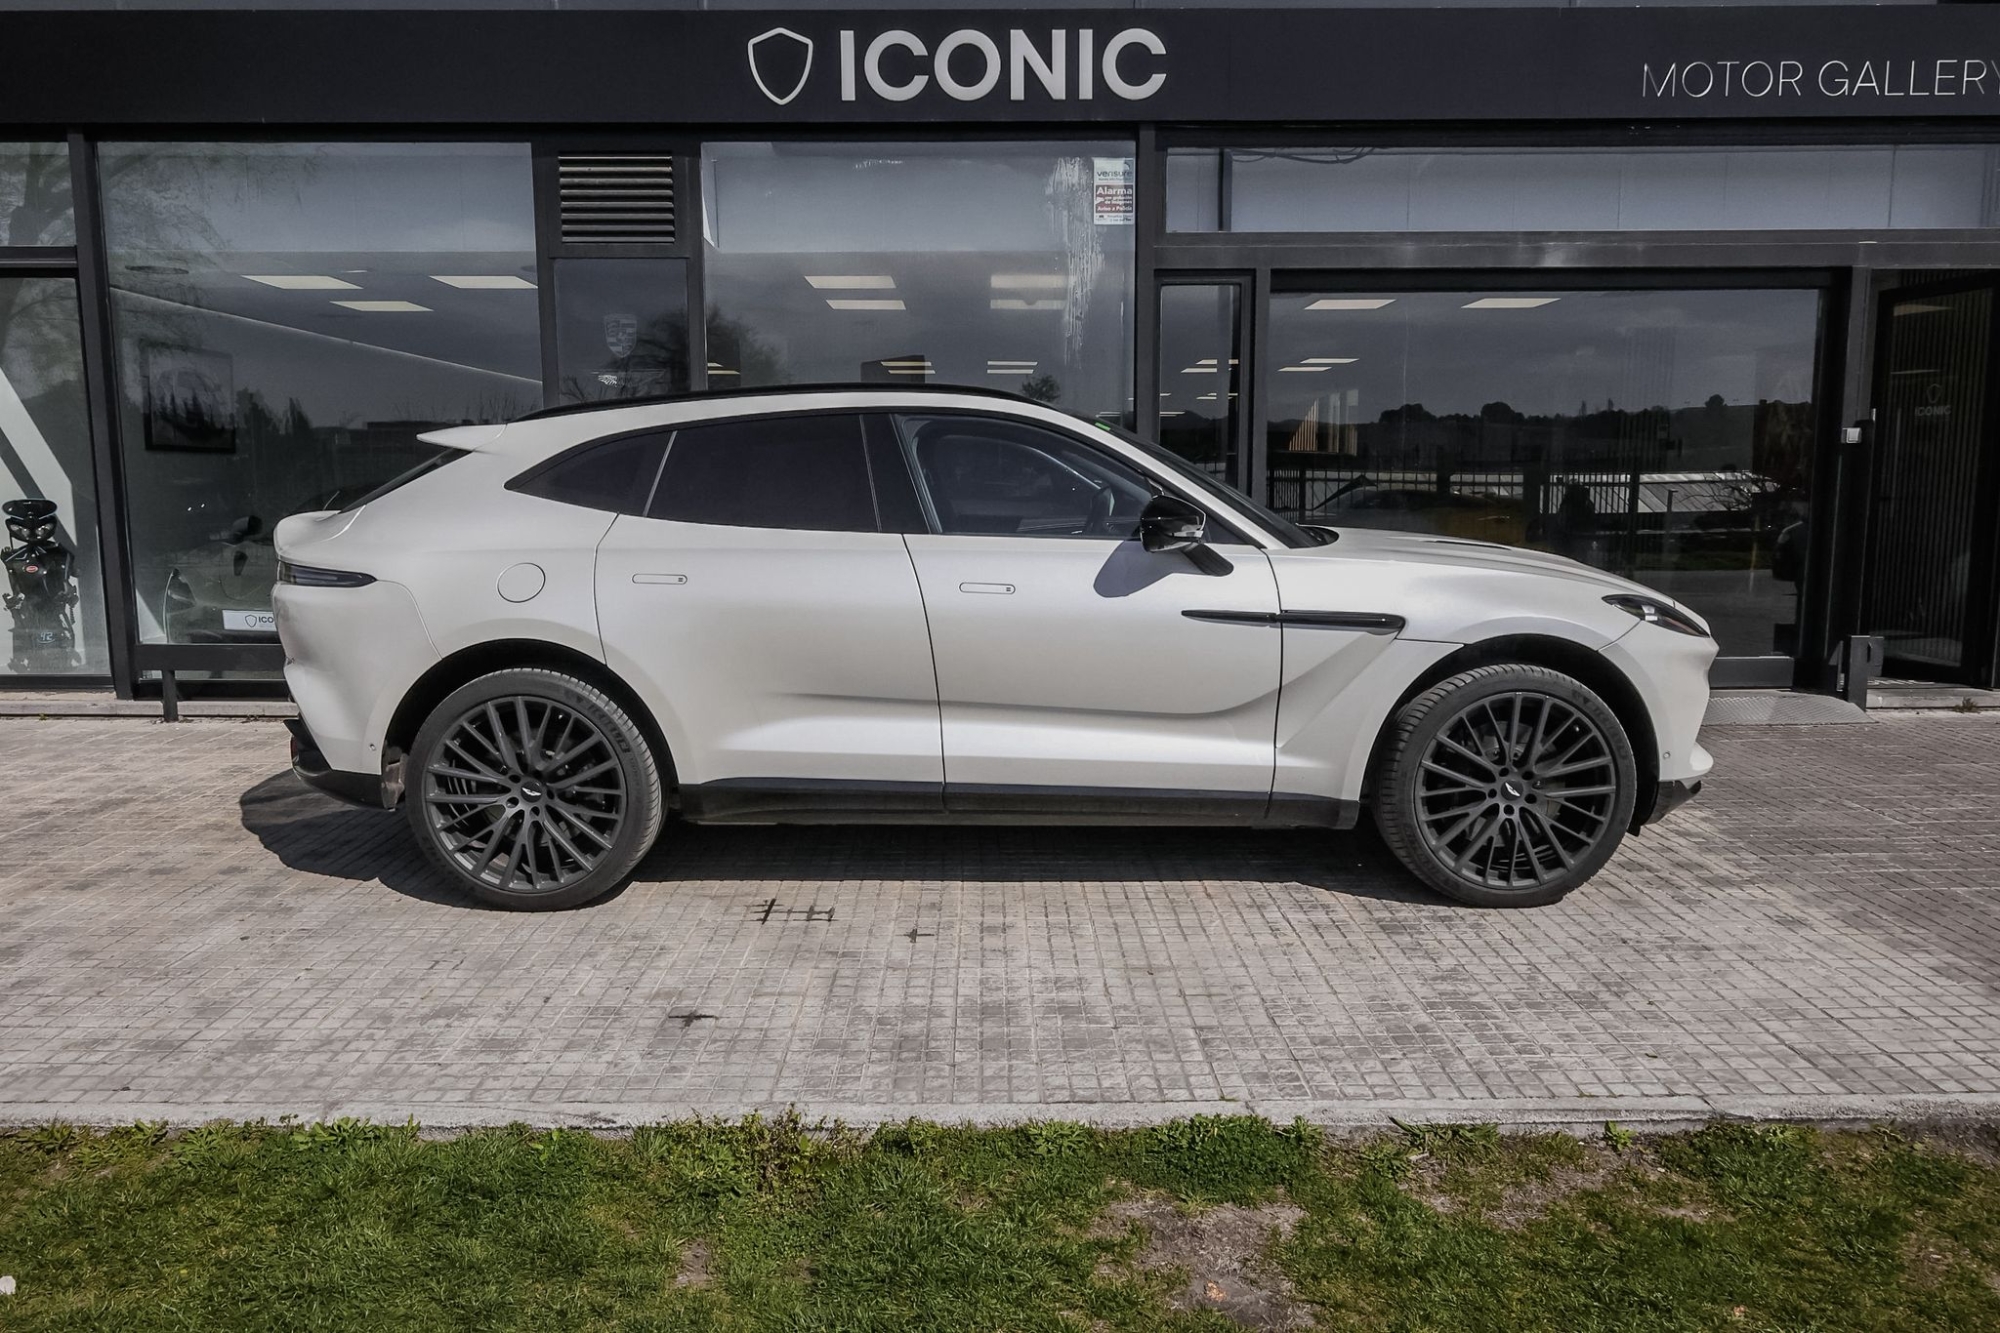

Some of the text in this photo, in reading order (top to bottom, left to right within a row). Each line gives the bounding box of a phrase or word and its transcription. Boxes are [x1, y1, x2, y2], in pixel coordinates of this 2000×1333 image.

[840, 28, 1167, 101] ICONIC
[1642, 60, 1803, 98] MOTOR
[1096, 186, 1133, 195] Alarma
[1914, 405, 1952, 416] ICONIC
